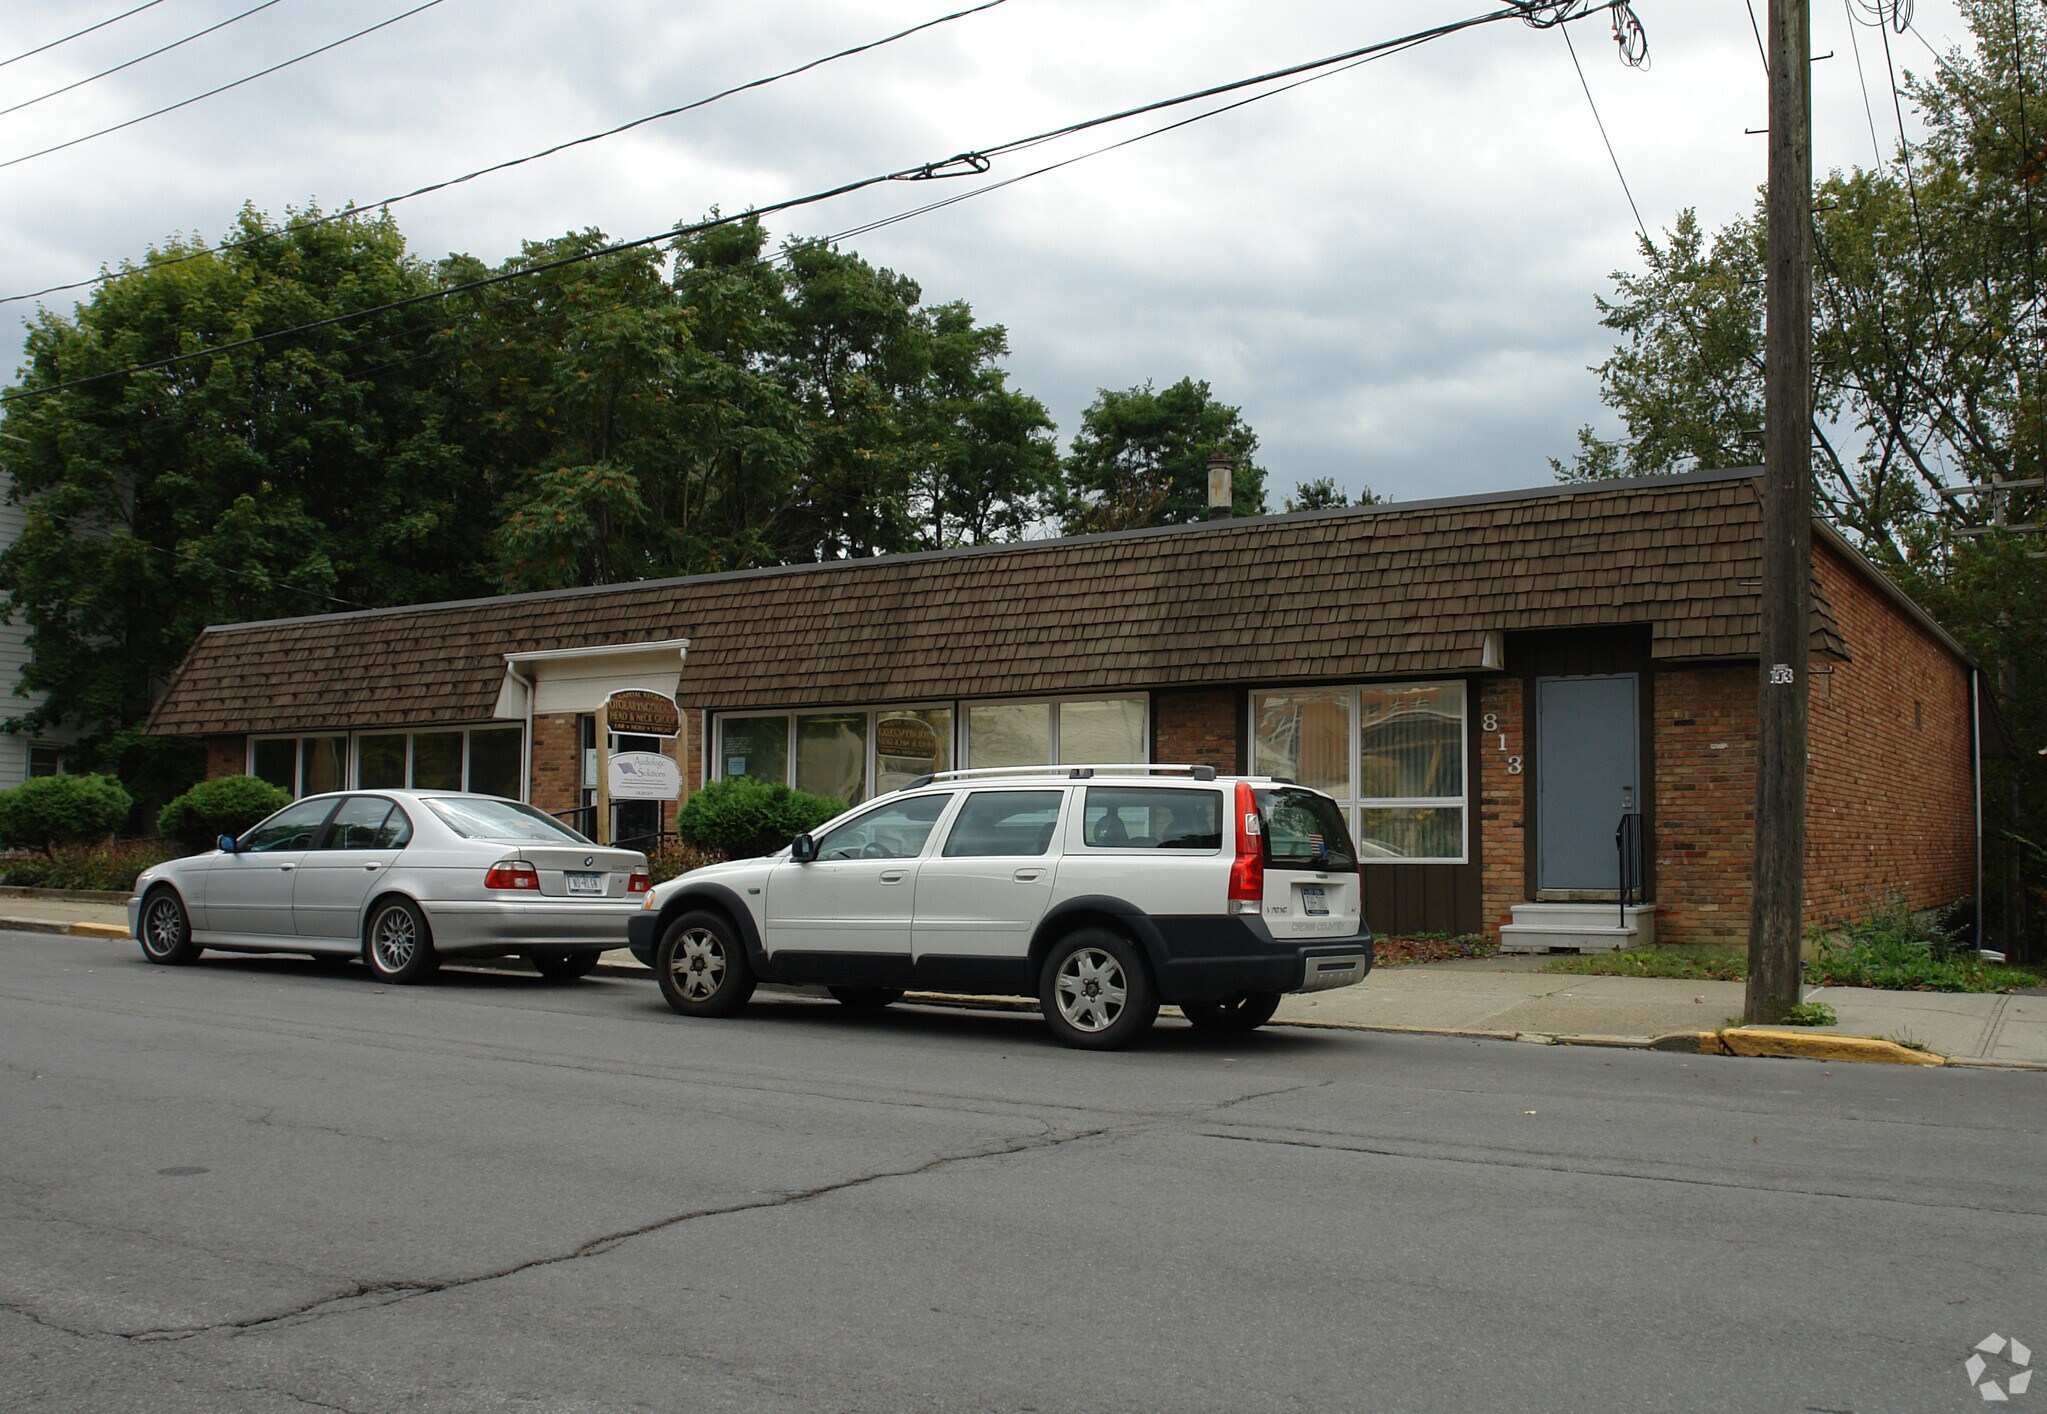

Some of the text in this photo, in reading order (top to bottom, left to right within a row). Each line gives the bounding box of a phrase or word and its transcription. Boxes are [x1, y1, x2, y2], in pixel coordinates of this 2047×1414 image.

[609, 700, 674, 714] OTOLARYNGOLOGY
[610, 711, 675, 724] HEAD & NECK GROUP
[637, 768, 666, 778] Solutions
